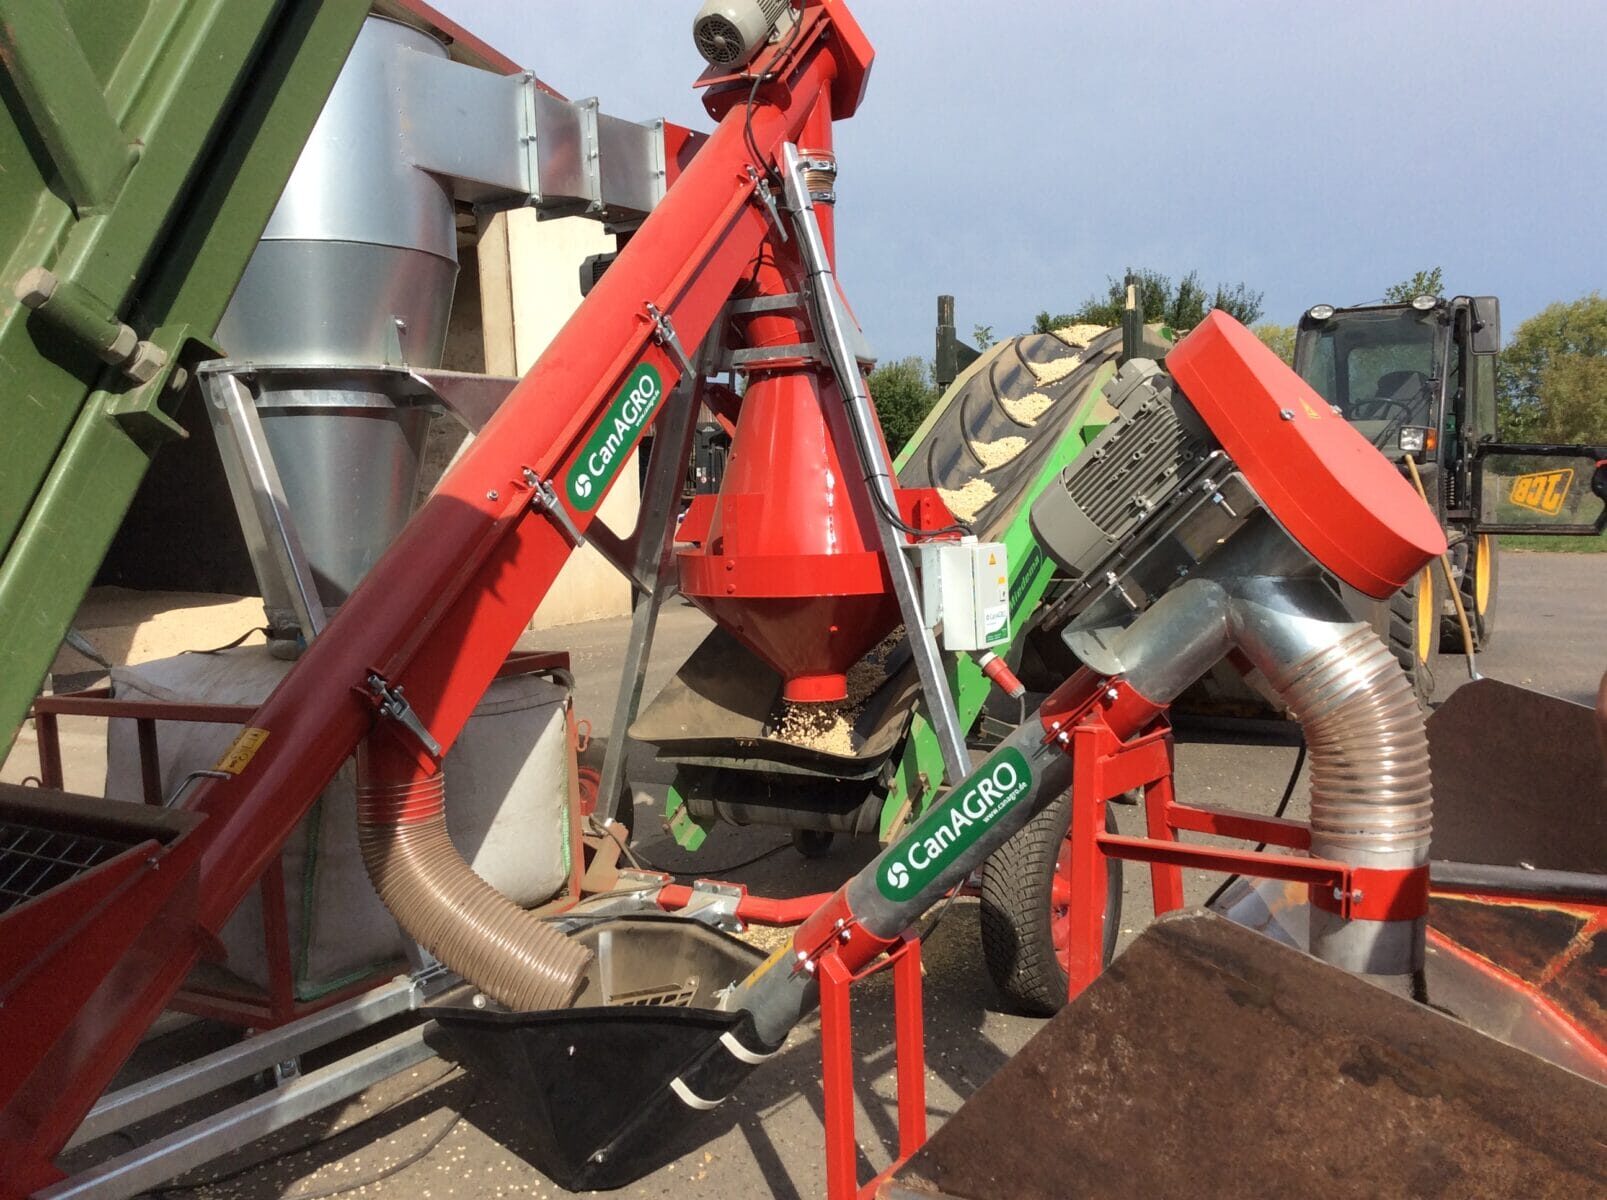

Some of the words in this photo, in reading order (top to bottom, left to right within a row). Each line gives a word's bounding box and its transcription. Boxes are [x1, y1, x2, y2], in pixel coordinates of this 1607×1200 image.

[588, 374, 655, 477] CanAGRO
[908, 761, 1017, 870] CanAGRO
[982, 781, 1028, 824] www.canagro.de
